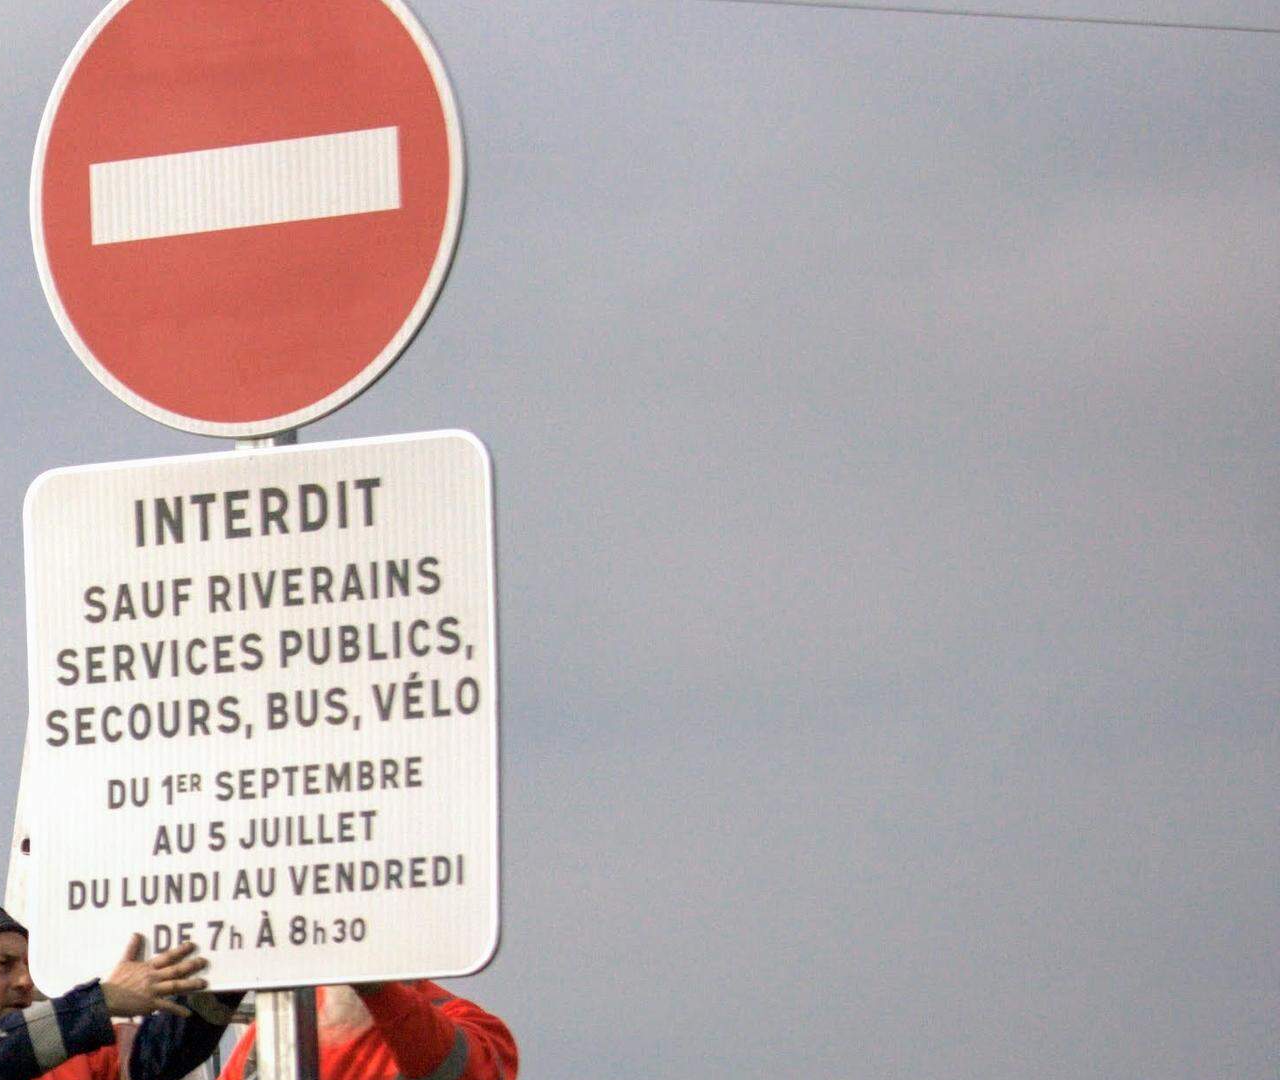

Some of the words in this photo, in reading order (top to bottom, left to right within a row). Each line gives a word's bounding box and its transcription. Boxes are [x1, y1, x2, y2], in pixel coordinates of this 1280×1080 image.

[134, 477, 382, 548] INTERDIT
[84, 578, 192, 624] SAUF
[208, 556, 441, 614] RIVERAINS
[57, 633, 264, 687] SERVICES
[280, 616, 475, 668] PUBLICS,
[46, 696, 253, 747] SECOURS,
[267, 687, 362, 731] BUS,
[372, 672, 480, 722] VÉLO
[108, 777, 150, 810] DU
[215, 756, 423, 802] SEPTEMBRE
[153, 823, 196, 856] AU
[208, 821, 227, 853] 5
[239, 810, 378, 851] JUILLET
[68, 878, 110, 911] DU
[122, 871, 220, 908] LUNDI
[233, 867, 277, 901] AU
[288, 854, 465, 897] VENDREDI
[207, 920, 243, 951] 7h
[256, 910, 276, 949] À
[289, 915, 366, 947] 8h30
